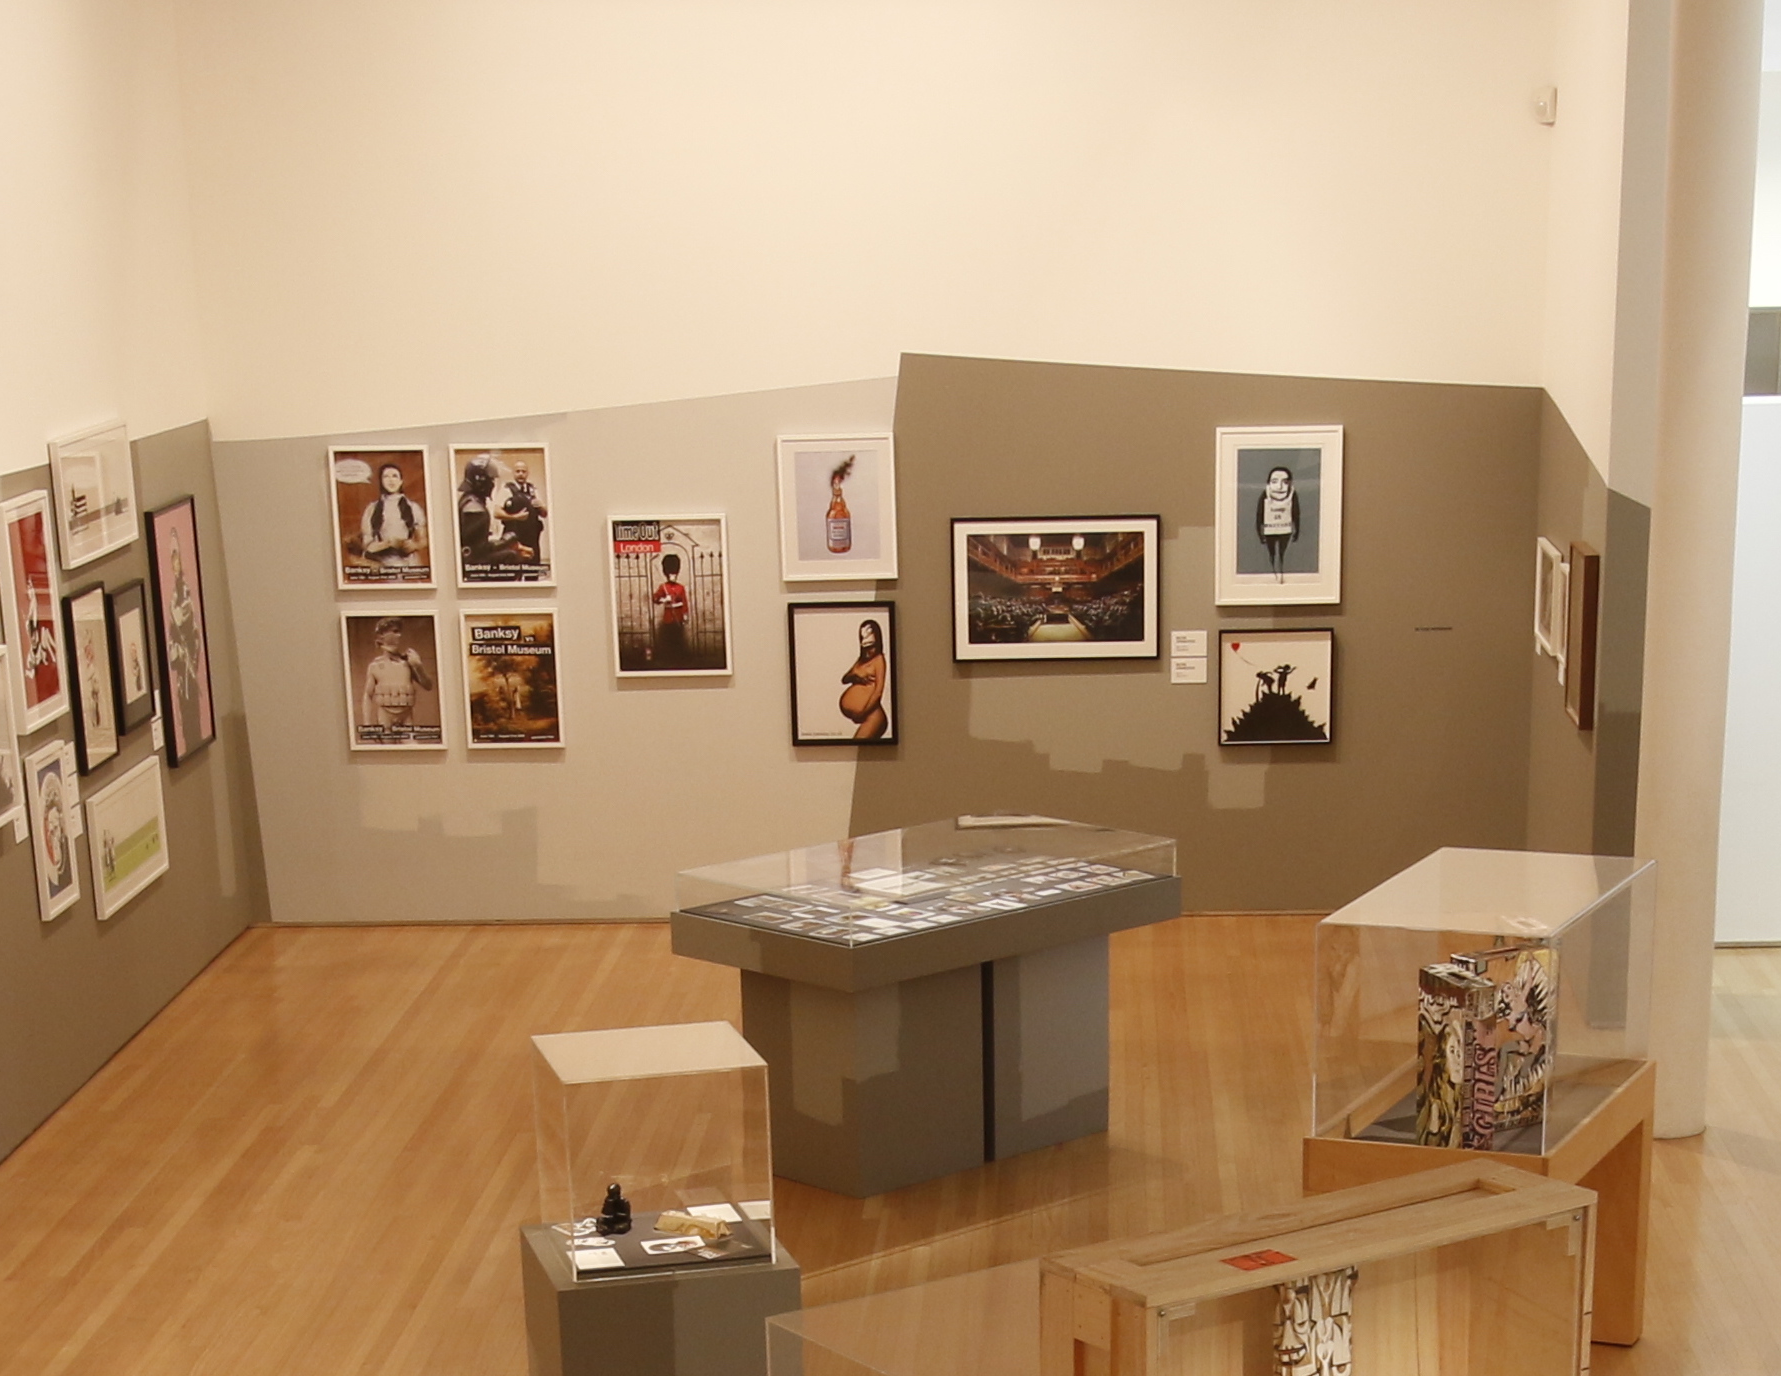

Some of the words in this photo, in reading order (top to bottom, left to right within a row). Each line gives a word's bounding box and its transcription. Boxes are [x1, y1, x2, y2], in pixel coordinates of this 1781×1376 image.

[640, 522, 659, 541] Out
[620, 543, 654, 552] London
[474, 628, 519, 640] Banksy
[472, 644, 505, 654] Bristol
[507, 645, 552, 654] Museum
